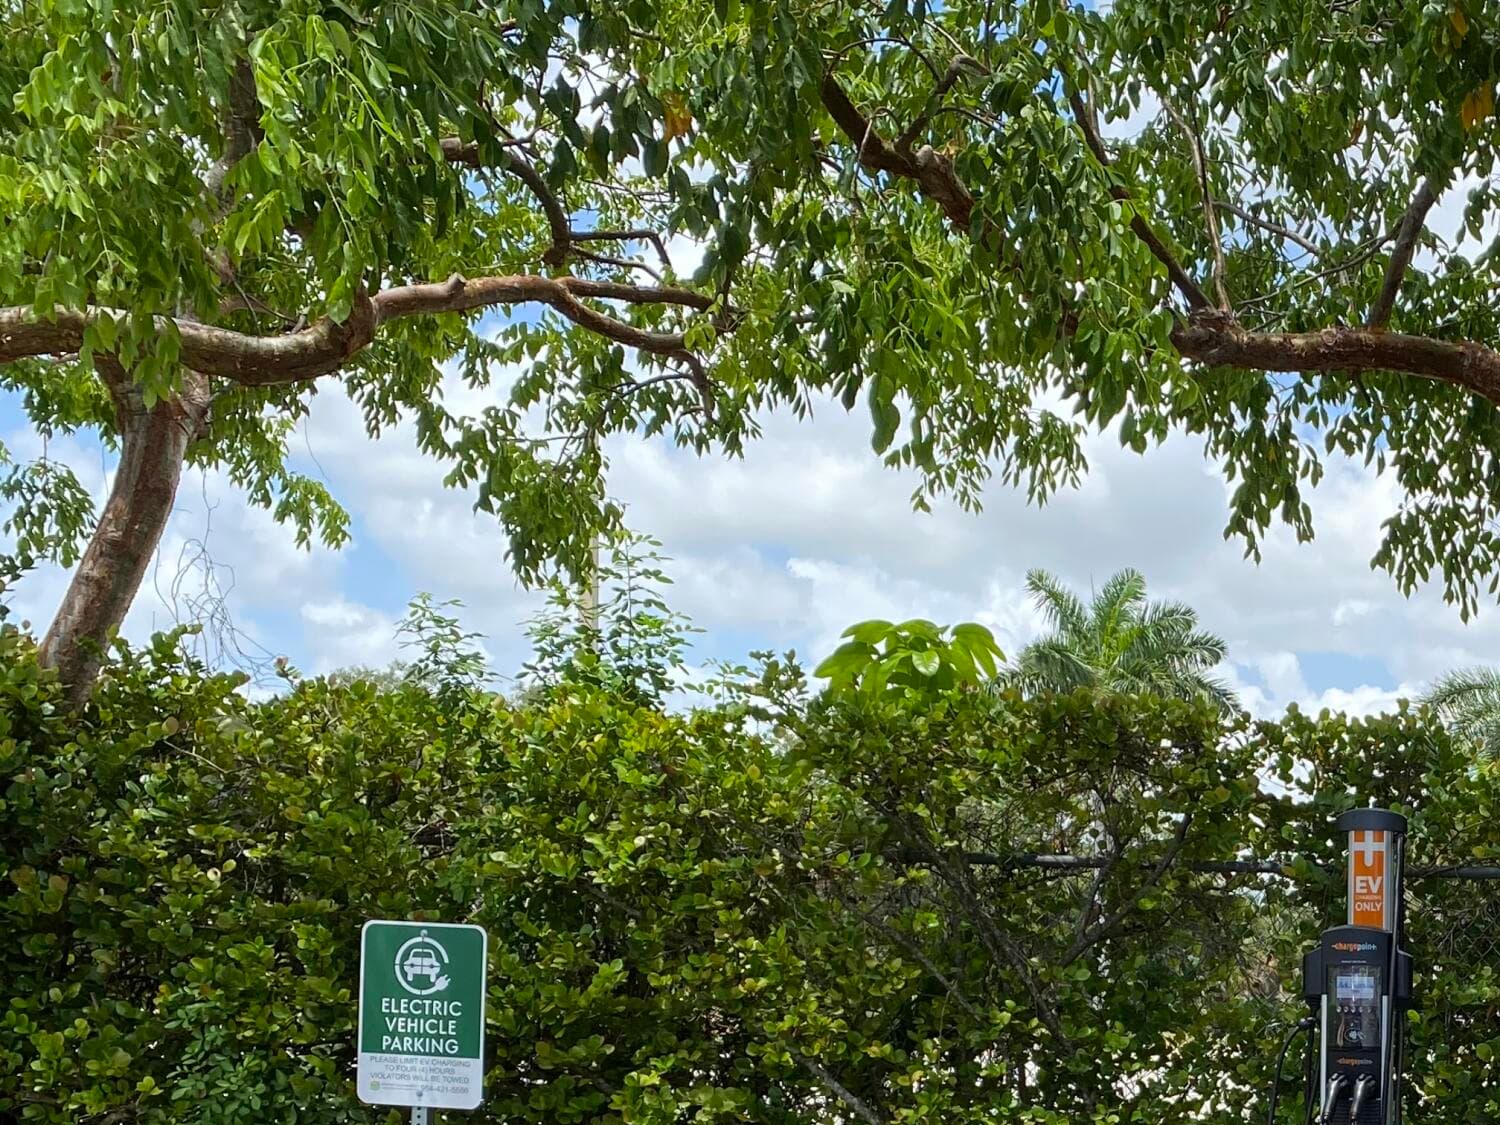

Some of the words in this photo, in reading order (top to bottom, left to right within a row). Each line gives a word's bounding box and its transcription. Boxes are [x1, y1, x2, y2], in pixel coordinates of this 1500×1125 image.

[1355, 876, 1382, 894] EV
[1355, 901, 1382, 912] ONLY
[381, 998, 462, 1016] ELECTRIC
[385, 1016, 457, 1035] VEHICLE
[382, 1035, 459, 1054] PARKING
[370, 1056, 398, 1064] PLEASE
[400, 1057, 418, 1065] LIMIT
[431, 1059, 471, 1068] CHARGING
[396, 1065, 417, 1073] FOUR
[429, 1067, 456, 1075] HOURS
[370, 1072, 411, 1081] VIOLATORS
[442, 1076, 470, 1084] TOWED
